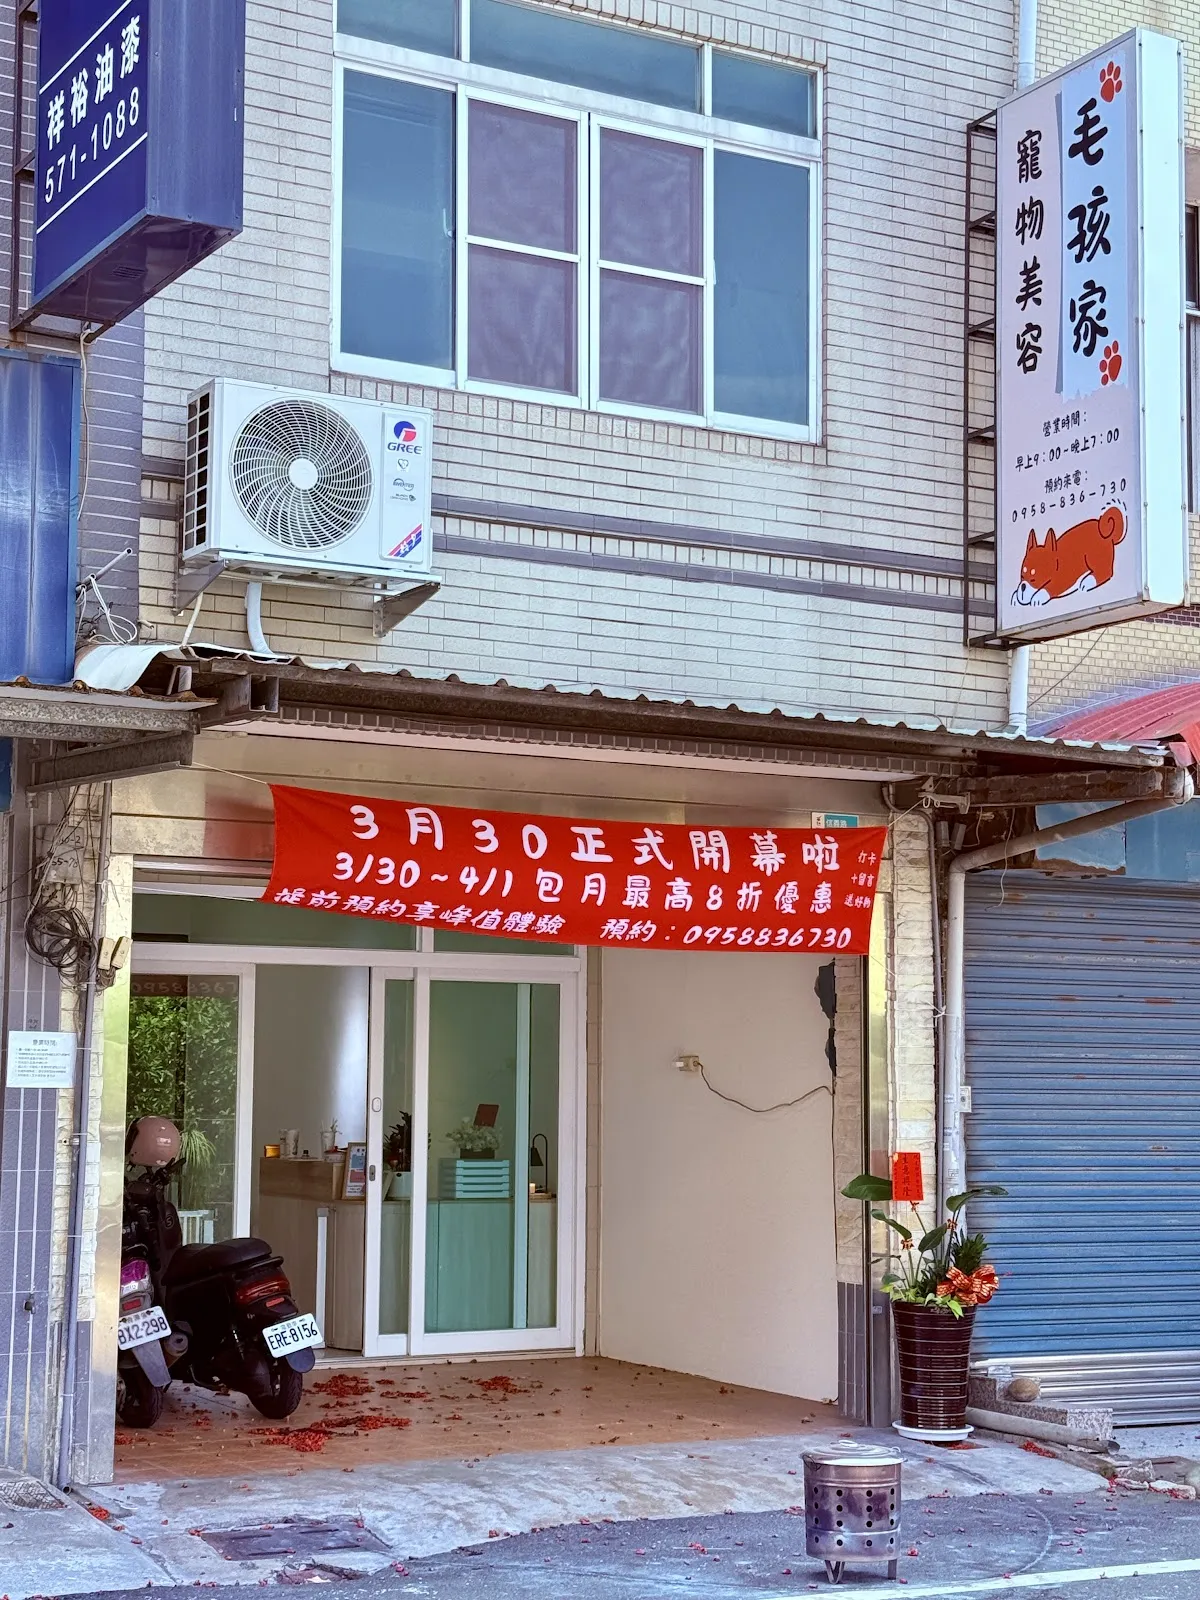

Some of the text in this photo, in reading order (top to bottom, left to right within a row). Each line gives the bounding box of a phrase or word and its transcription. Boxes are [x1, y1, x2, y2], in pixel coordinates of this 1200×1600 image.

[47, 15, 140, 150] 祥裕油漆
[45, 86, 140, 203] 571-1088
[1067, 97, 1112, 357] 毛孩家
[1015, 129, 1043, 375] 寵物美容
[387, 442, 422, 454] GREE
[1012, 478, 1126, 523] 0958-836-730
[349, 804, 841, 877] 3月30正式開幕啦
[857, 850, 877, 866] 打卡
[274, 887, 566, 935] 提前預約享峰值體驗
[118, 1316, 168, 1345] BX2-298
[267, 1321, 318, 1350] ERE-8156
